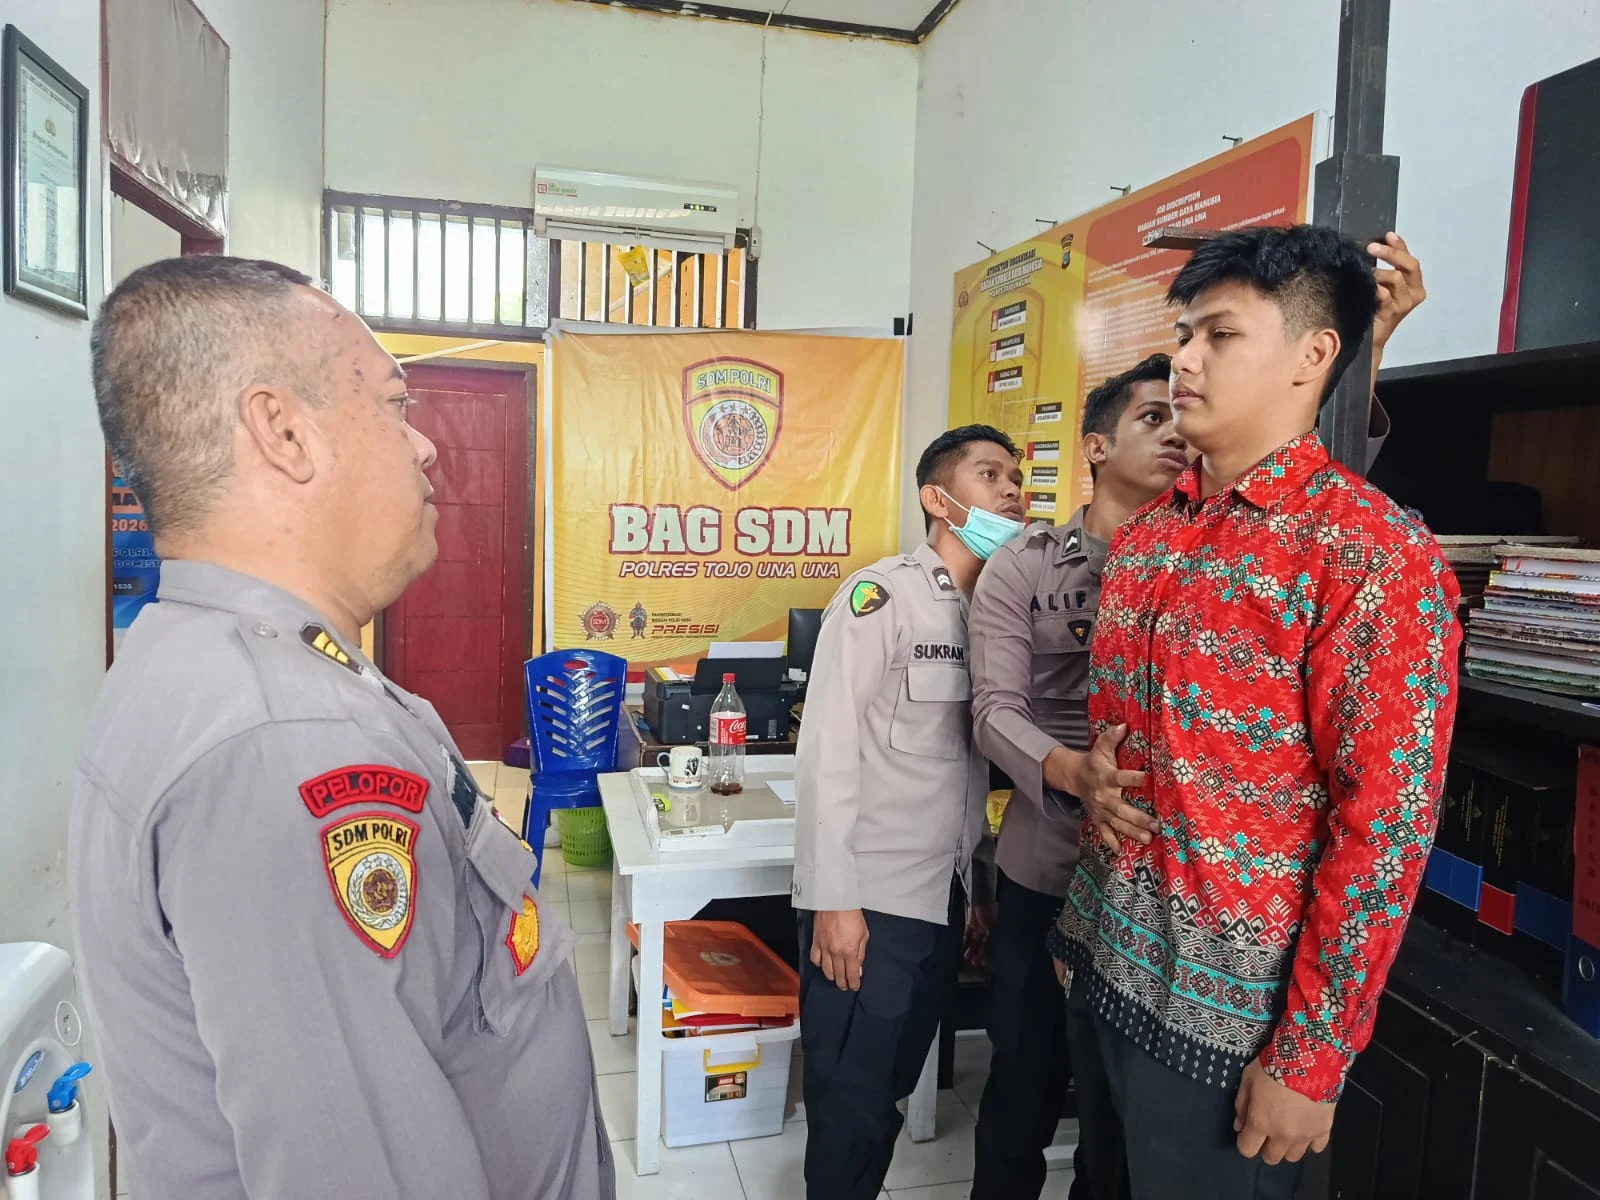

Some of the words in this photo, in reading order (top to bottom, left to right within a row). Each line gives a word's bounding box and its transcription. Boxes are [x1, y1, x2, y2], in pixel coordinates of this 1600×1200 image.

[696, 370, 728, 390] SDM
[730, 370, 771, 393] POLRI
[609, 503, 722, 556] BAG
[735, 507, 851, 556] SDM
[619, 560, 698, 578] POLRES
[704, 561, 752, 578] TOJO
[756, 562, 796, 578] UNA
[801, 562, 840, 578] UNA
[1030, 590, 1086, 613] ALIF
[652, 624, 720, 635] PRESISI
[914, 644, 964, 661] SUKRAN
[312, 773, 419, 808] PELOPOR
[333, 824, 368, 851] SDM
[373, 823, 408, 847] POLRI
